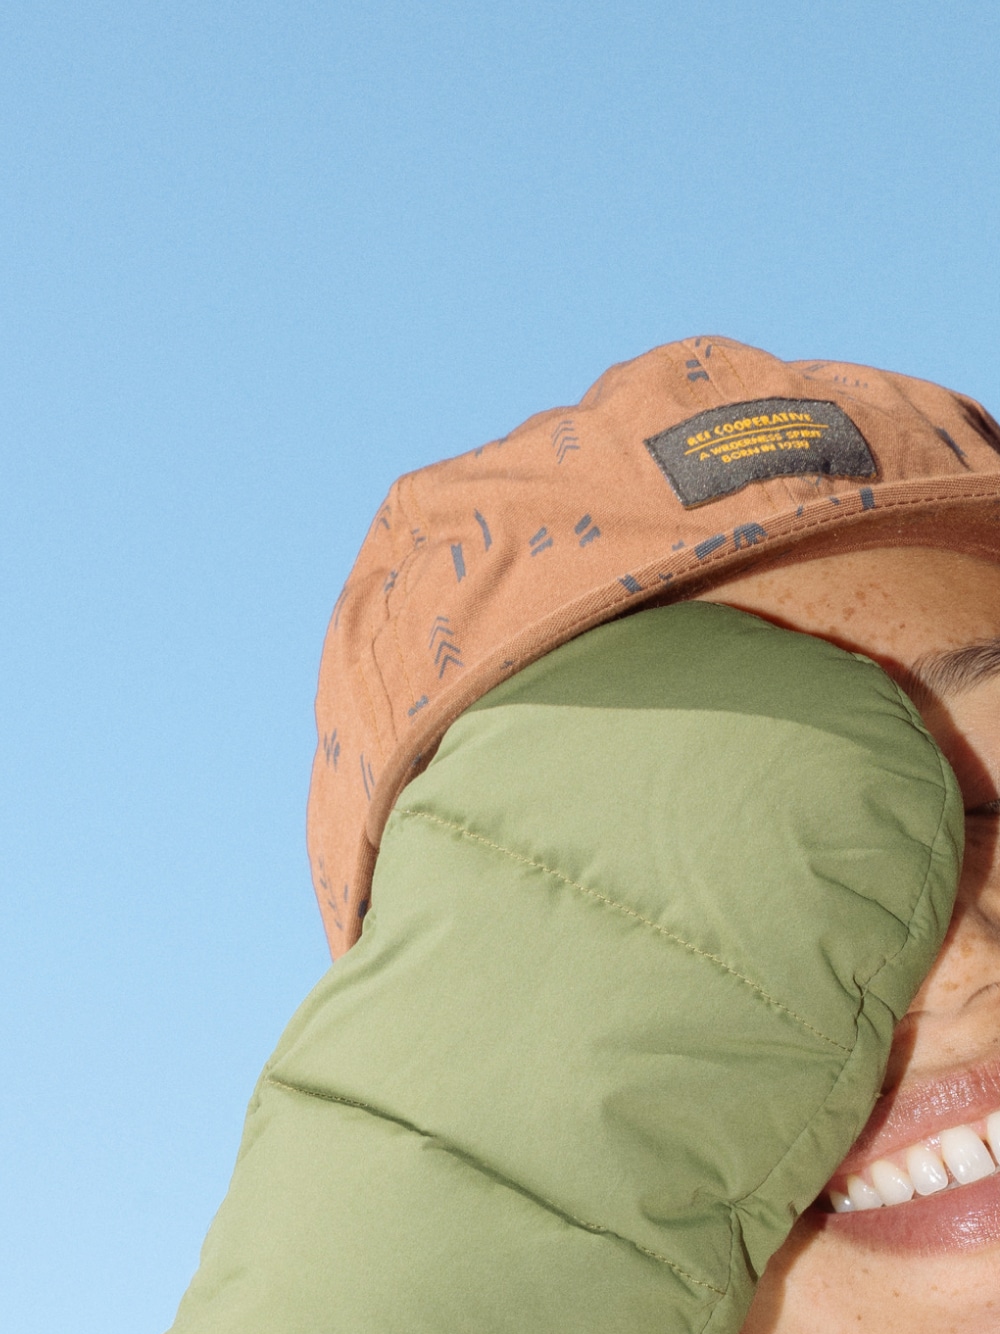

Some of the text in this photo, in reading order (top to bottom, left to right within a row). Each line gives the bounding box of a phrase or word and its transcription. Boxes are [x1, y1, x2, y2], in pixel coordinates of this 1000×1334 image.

[687, 412, 813, 447] REI COOPERATIVE
[700, 429, 822, 461] A WILDERNESS SPIRIT
[721, 446, 760, 463] BORN
[760, 443, 777, 453] IN
